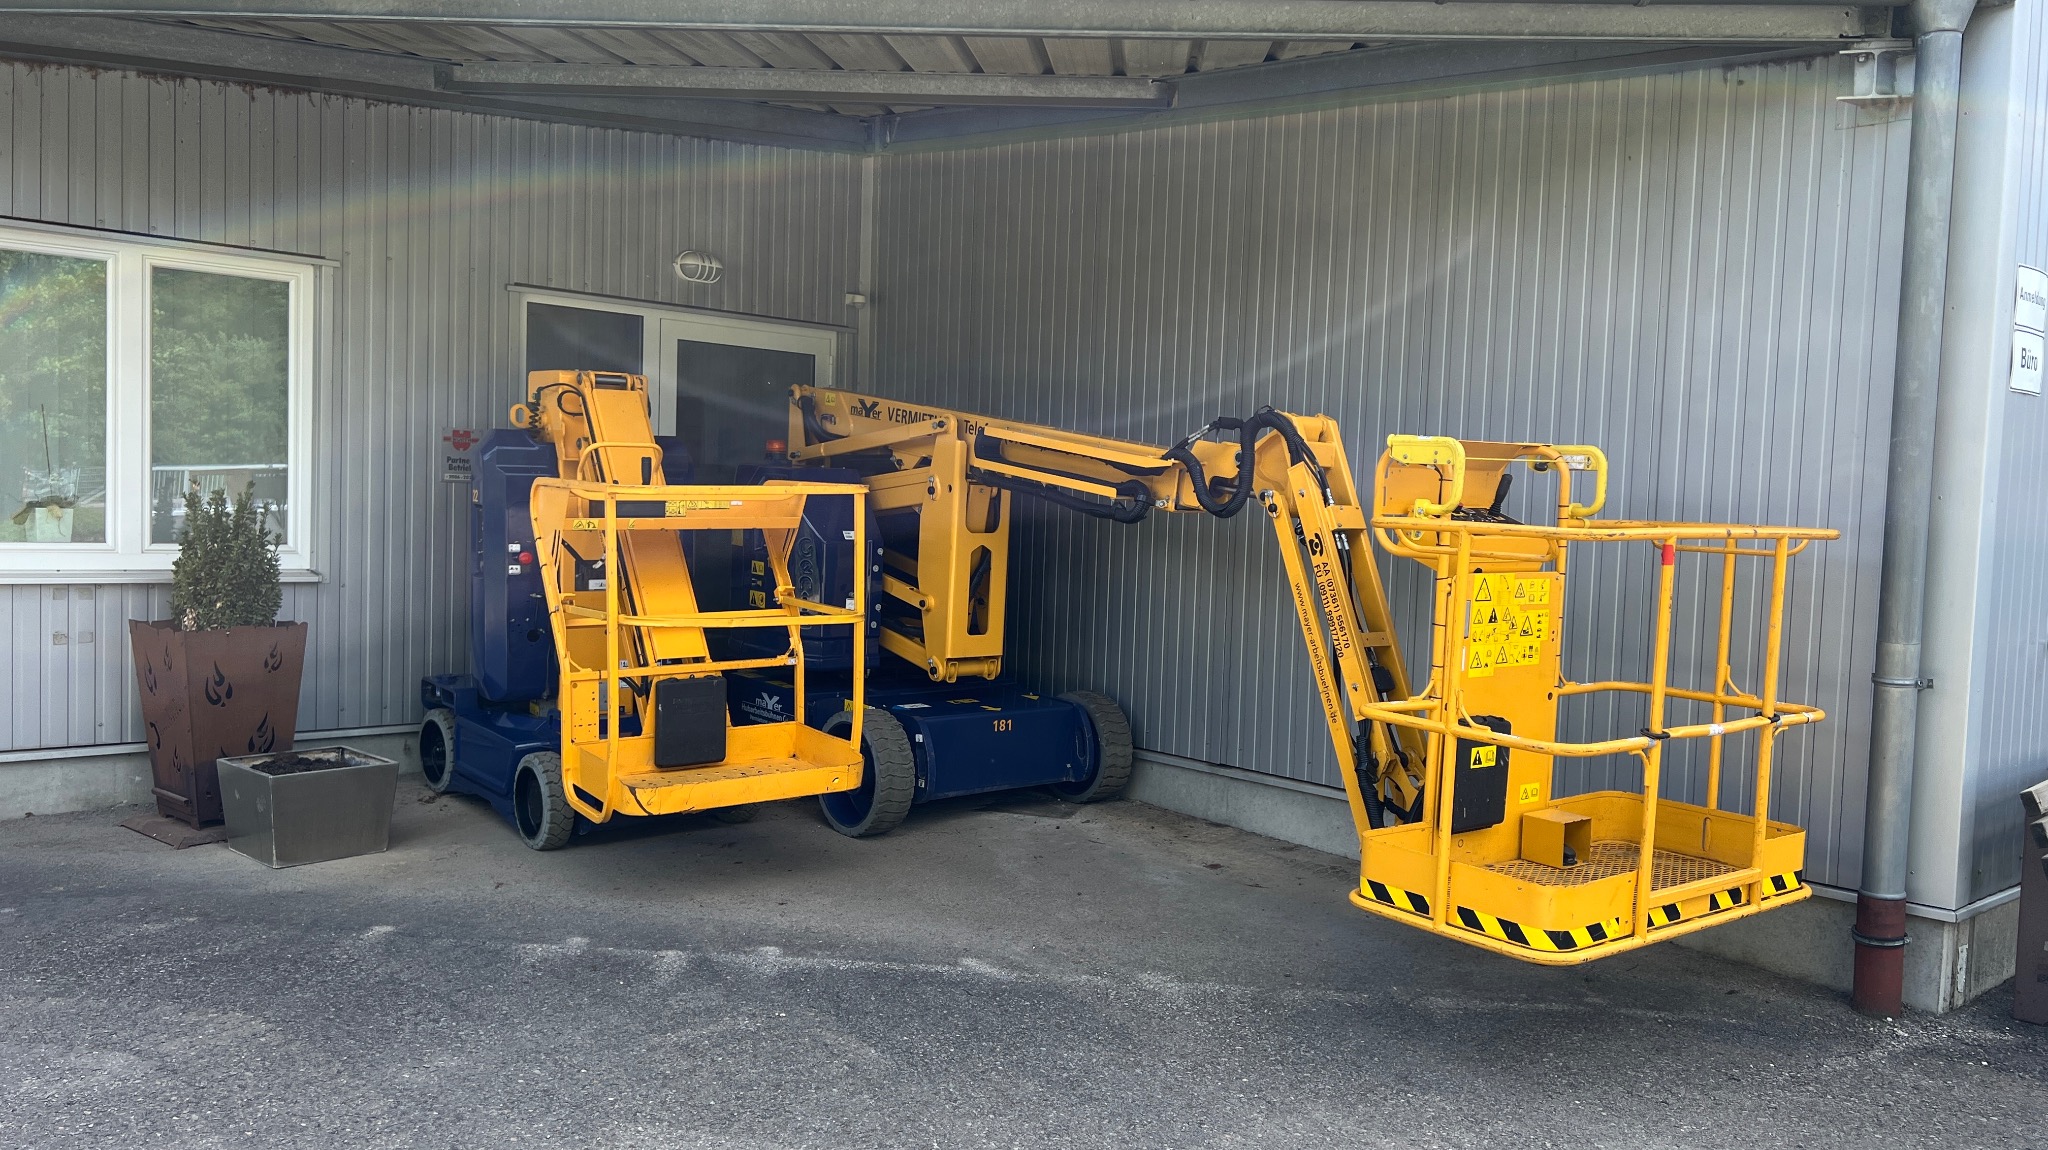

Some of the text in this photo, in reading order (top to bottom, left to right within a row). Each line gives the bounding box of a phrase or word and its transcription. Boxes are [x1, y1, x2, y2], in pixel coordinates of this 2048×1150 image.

[2021, 347, 2039, 372] Büro
[446, 456, 470, 465] Partne
[1318, 581, 1331, 609] (0911)
[1321, 562, 1351, 649] AA (07361) 556170
[1295, 582, 1337, 724] www.mayer-arbeitsbuehnen.de
[992, 719, 1013, 732] 181
